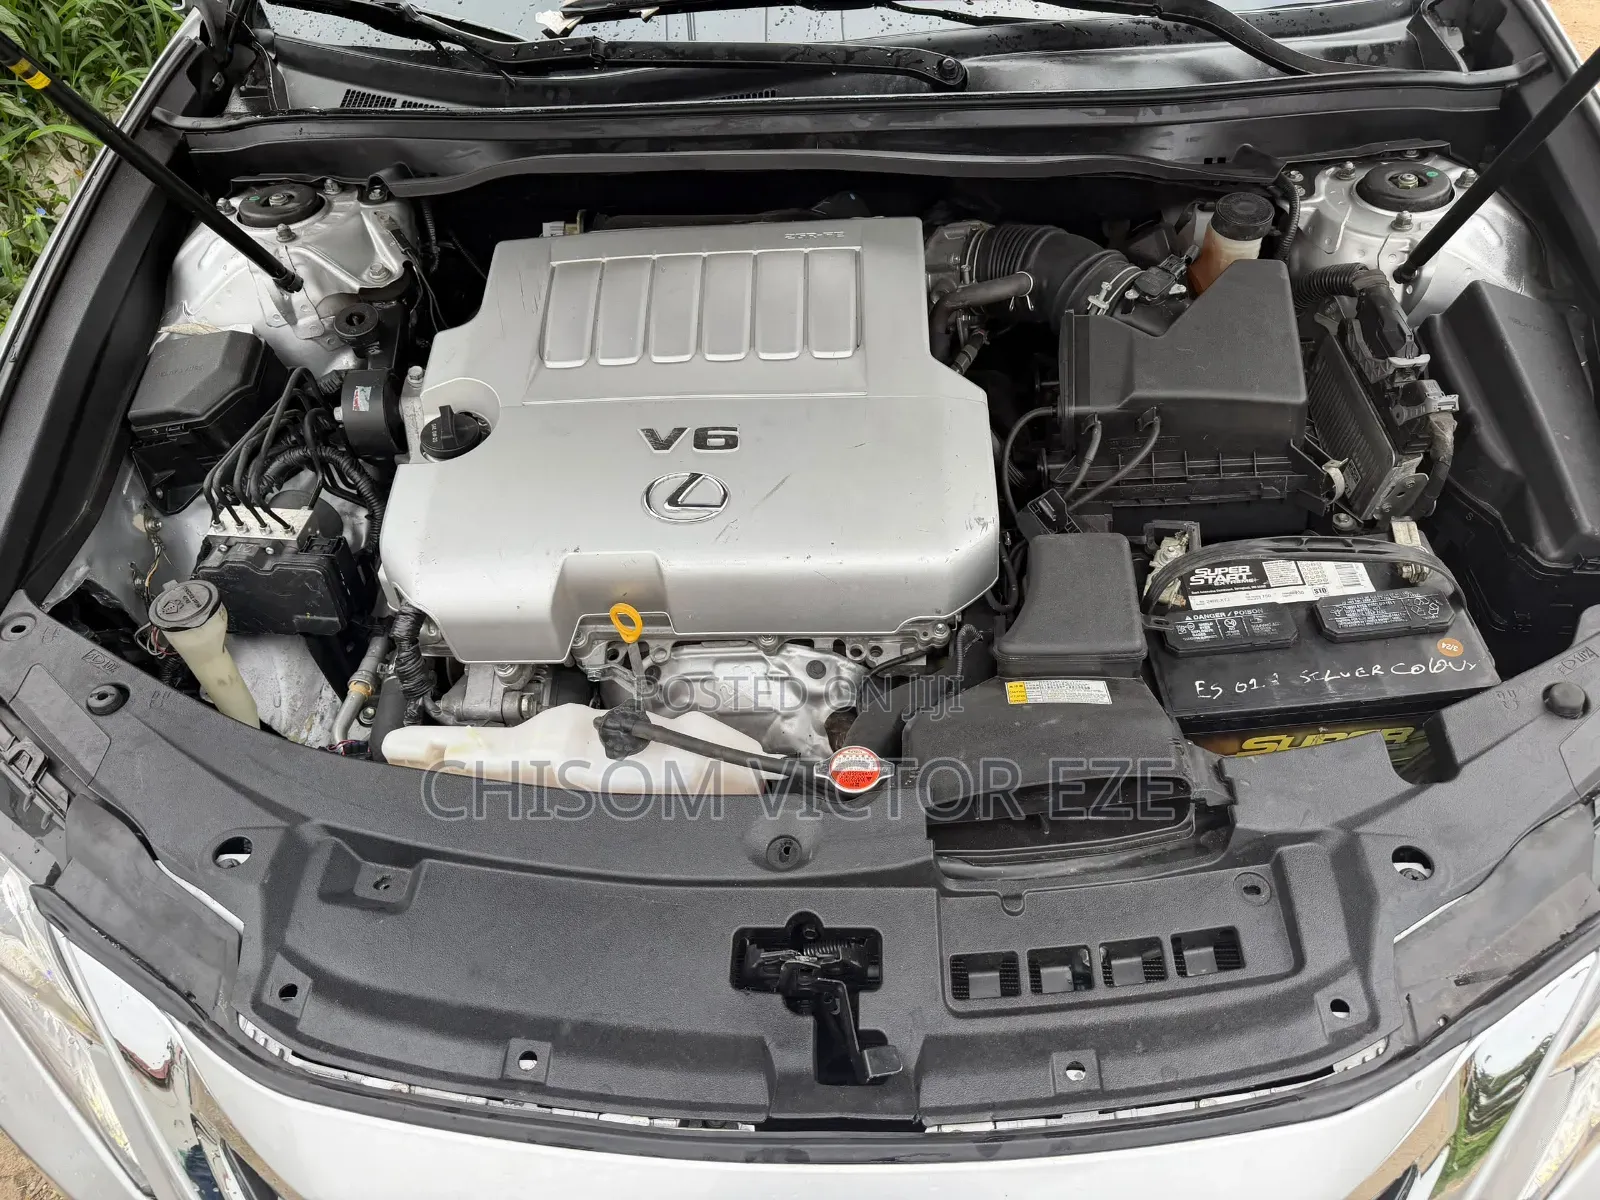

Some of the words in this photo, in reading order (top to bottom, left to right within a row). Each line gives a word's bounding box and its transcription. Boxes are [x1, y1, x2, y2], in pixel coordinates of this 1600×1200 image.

[637, 427, 740, 453] V6
[1195, 565, 1250, 576] SUPER
[1189, 572, 1253, 586] START
[1193, 612, 1226, 621] DANGER
[1233, 608, 1264, 617] POISON
[1195, 680, 1223, 700] ES
